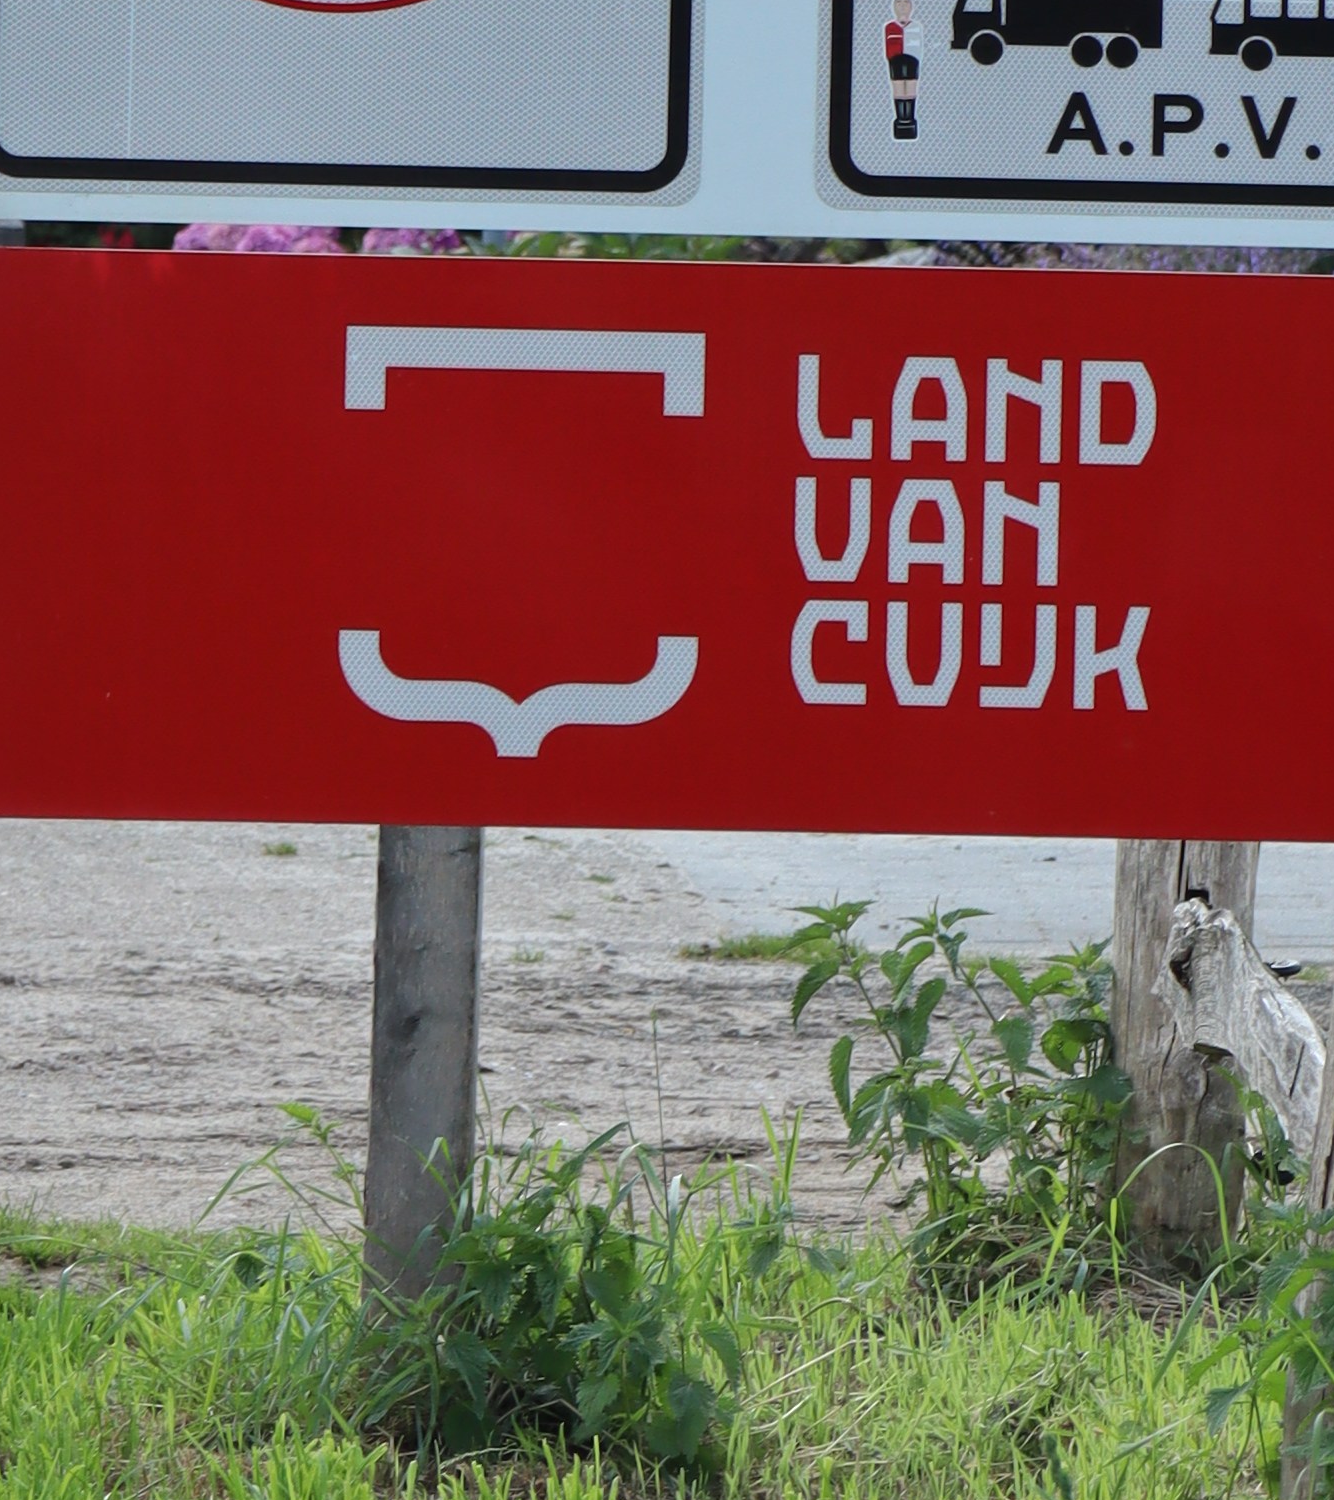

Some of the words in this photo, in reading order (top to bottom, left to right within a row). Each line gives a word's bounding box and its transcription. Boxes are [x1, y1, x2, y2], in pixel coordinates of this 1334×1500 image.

[1046, 91, 1321, 161] A.P.V.
[797, 353, 1157, 466] LAND
[794, 476, 1060, 587] VAN
